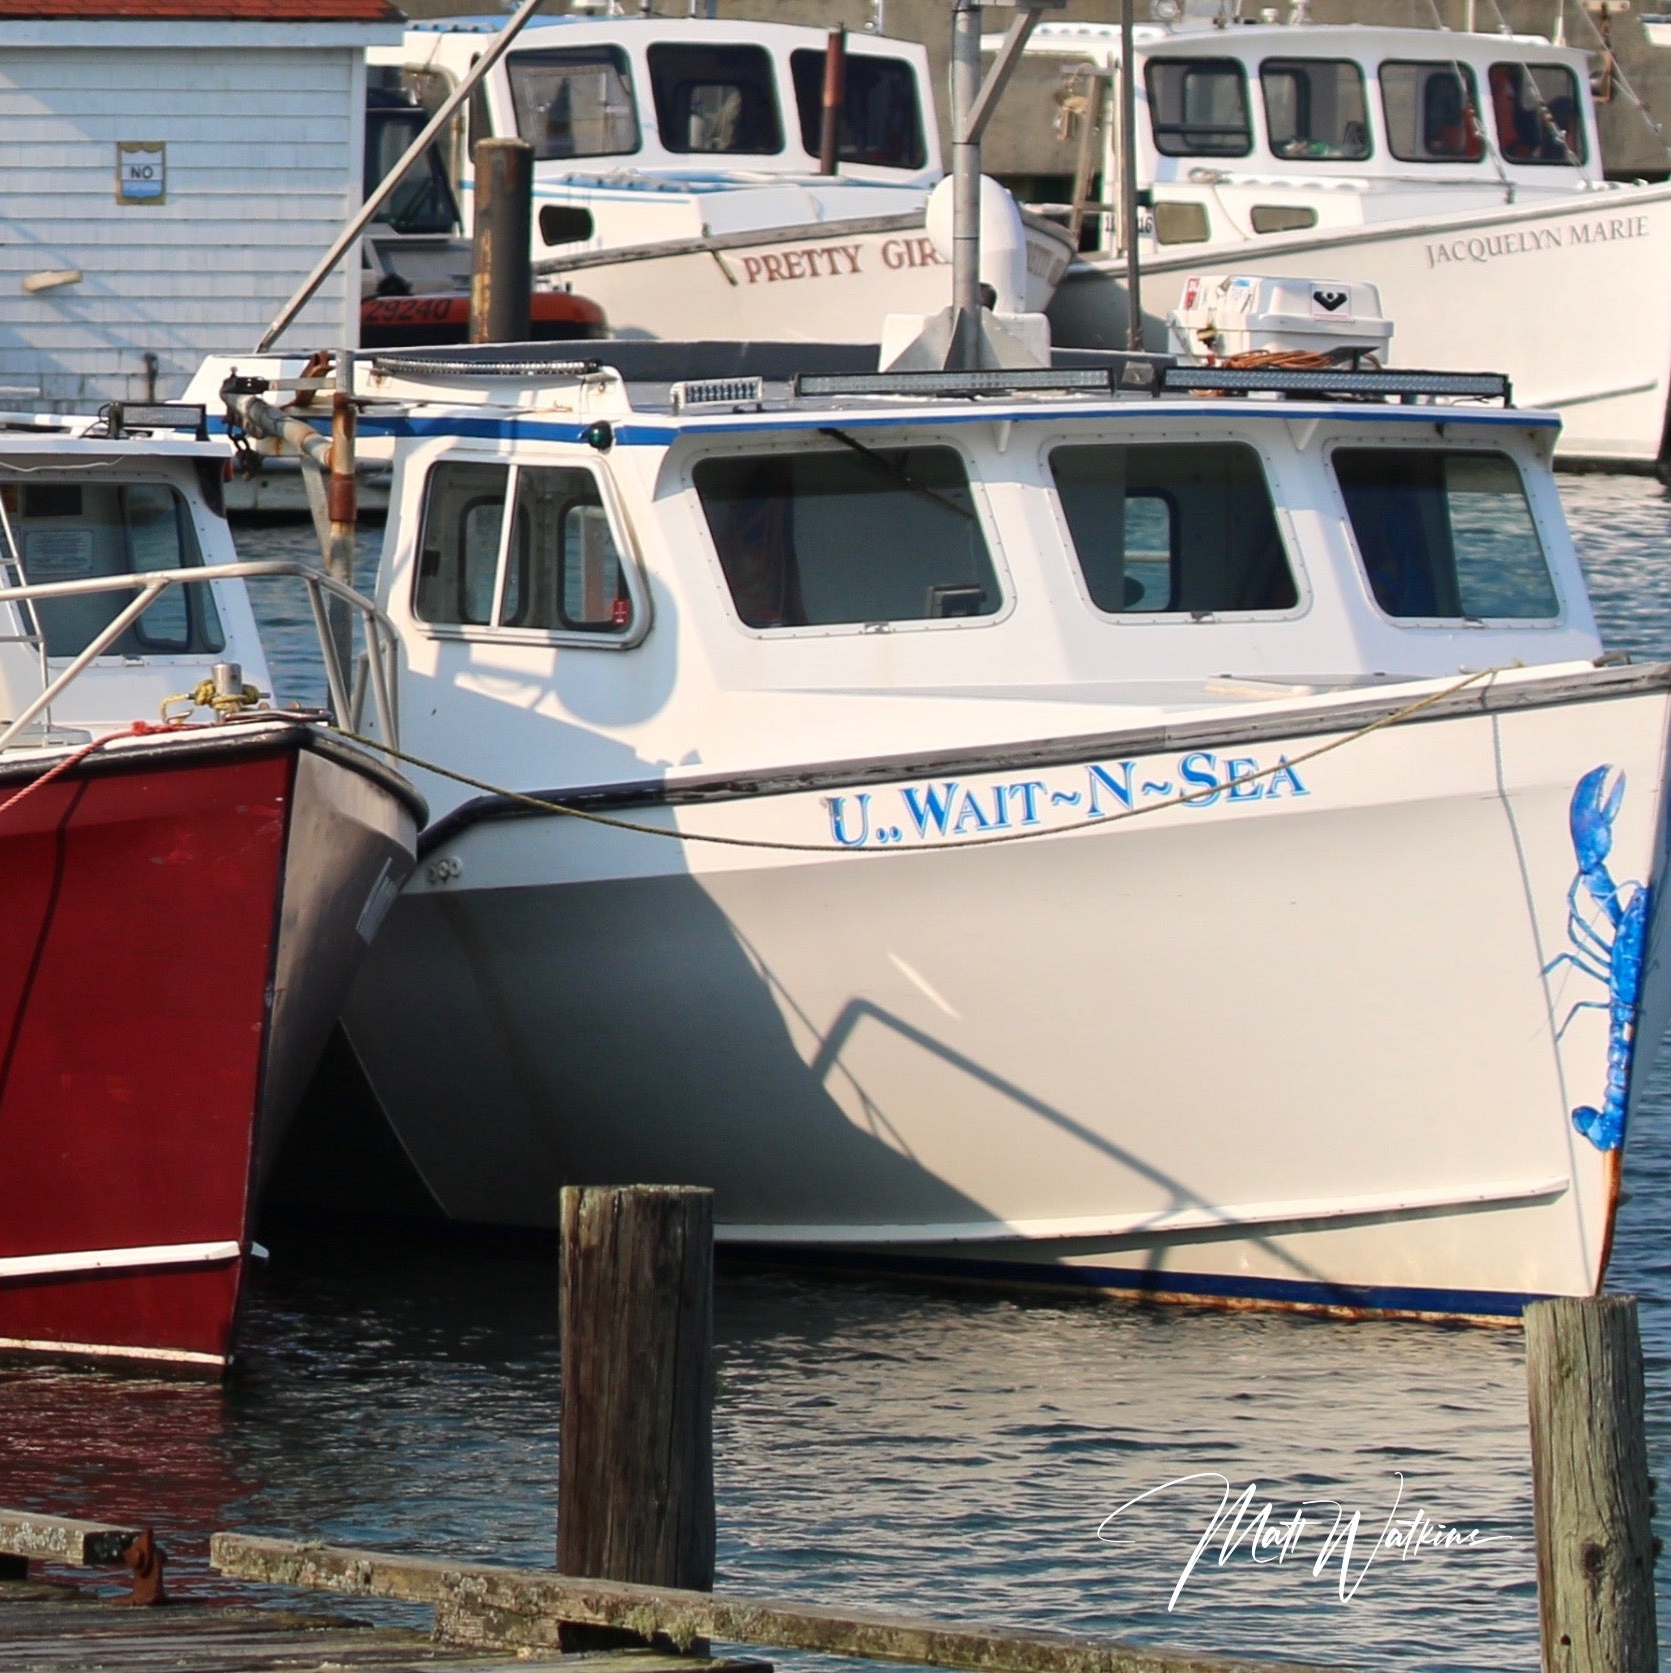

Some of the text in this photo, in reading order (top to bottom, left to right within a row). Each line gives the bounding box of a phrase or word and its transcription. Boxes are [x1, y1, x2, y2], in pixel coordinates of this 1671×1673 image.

[130, 165, 154, 179] NO
[741, 237, 953, 284] PRETTY GIR
[1425, 215, 1650, 269] JACQUELYN MARIE
